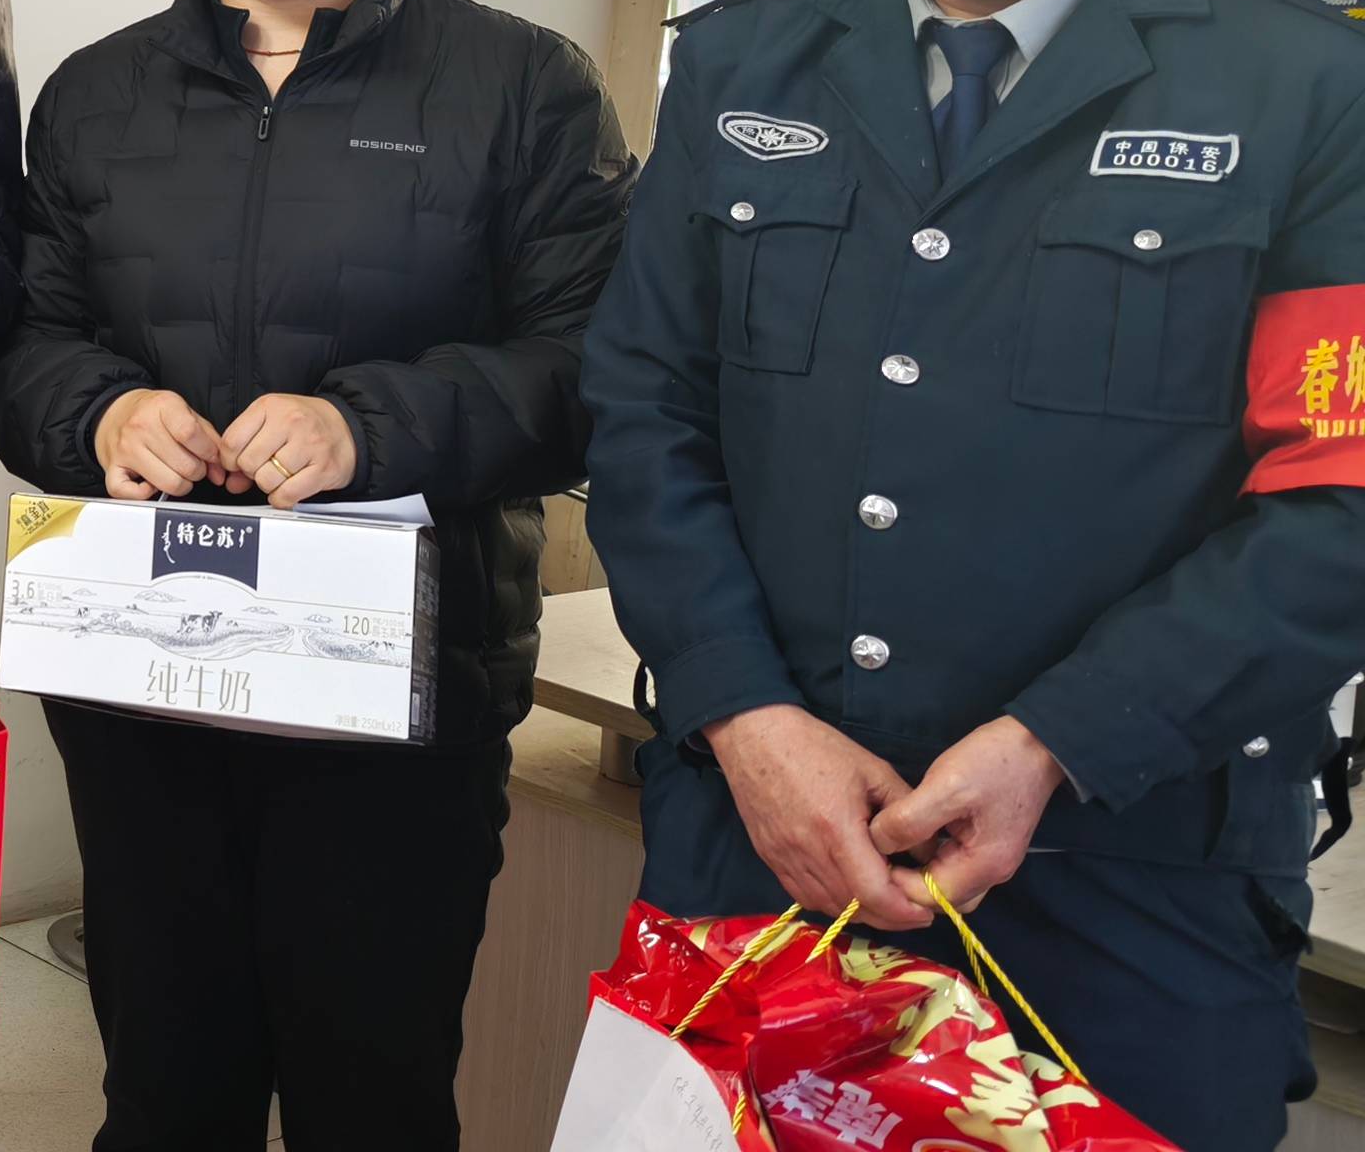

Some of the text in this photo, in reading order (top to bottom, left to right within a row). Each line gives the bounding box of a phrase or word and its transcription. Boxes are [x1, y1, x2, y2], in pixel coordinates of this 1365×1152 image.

[350, 139, 427, 153] BOSIDENG
[1115, 140, 1221, 160] 中国保安
[1113, 153, 1217, 173] 000016
[177, 522, 235, 549] 特仑苏
[342, 615, 370, 636] 120
[146, 660, 252, 714] 纯牛奶
